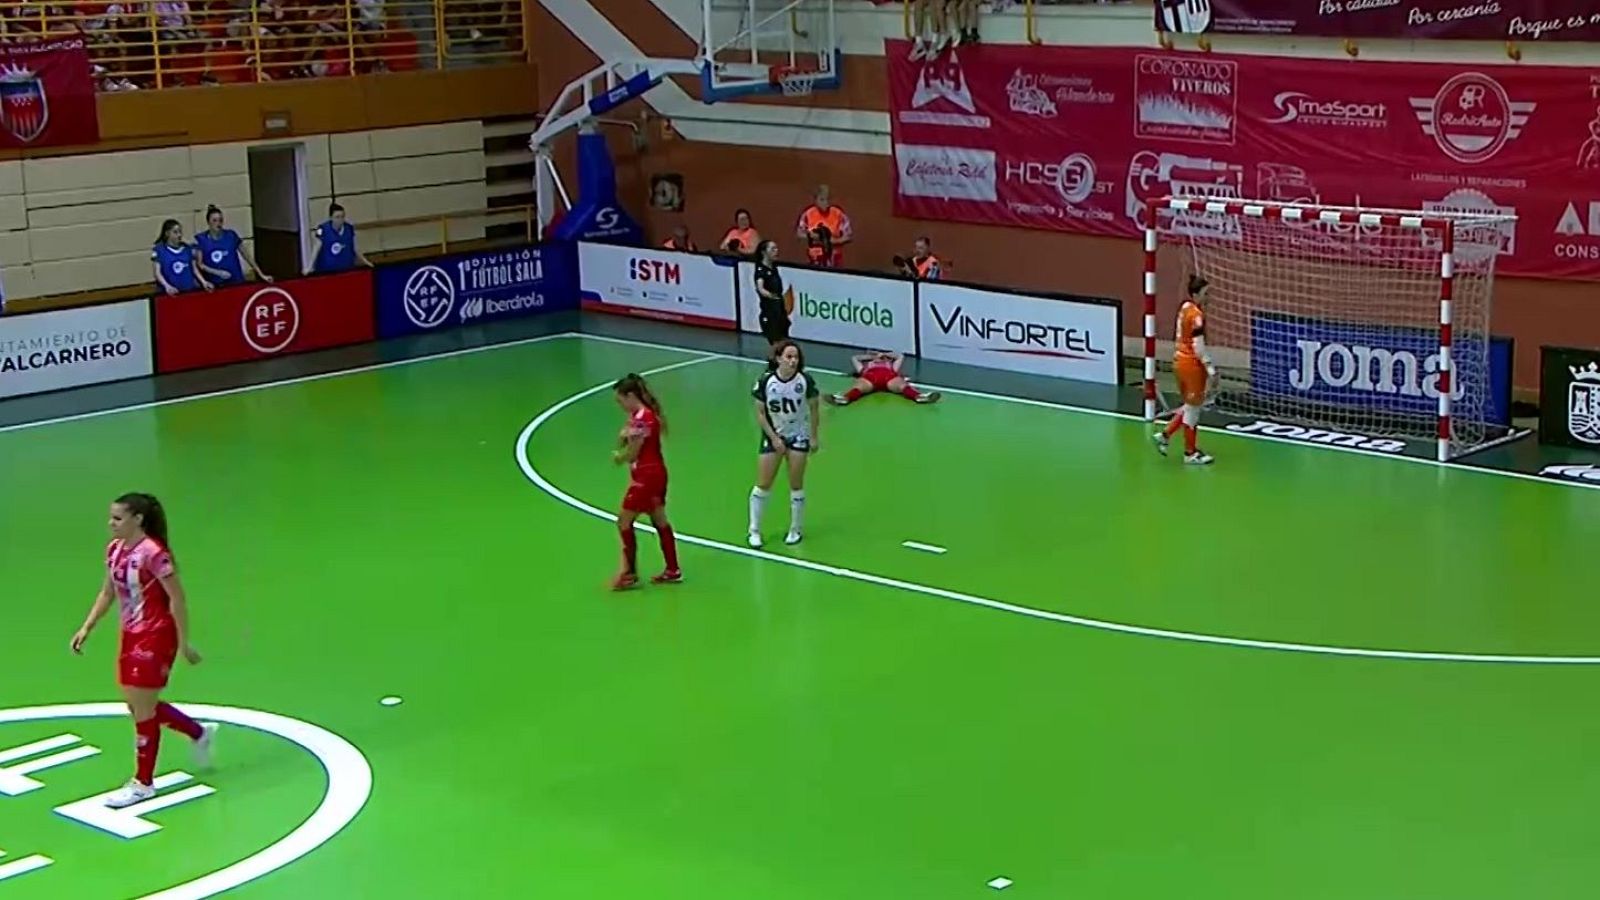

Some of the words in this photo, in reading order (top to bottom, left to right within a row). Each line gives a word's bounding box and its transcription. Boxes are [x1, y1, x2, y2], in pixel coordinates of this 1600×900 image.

[1408, 8, 1433, 25] Por
[1508, 16, 1563, 39] Porque
[1567, 17, 1585, 28] es
[1140, 59, 1231, 80] CORONADO
[1172, 77, 1231, 96] VIVEROS
[516, 258, 544, 283] SALA
[255, 302, 287, 320] RF
[799, 290, 894, 329] Iberdrola
[107, 325, 128, 338] DE
[256, 320, 287, 339] EF
[929, 302, 1106, 354] VINFORTEL
